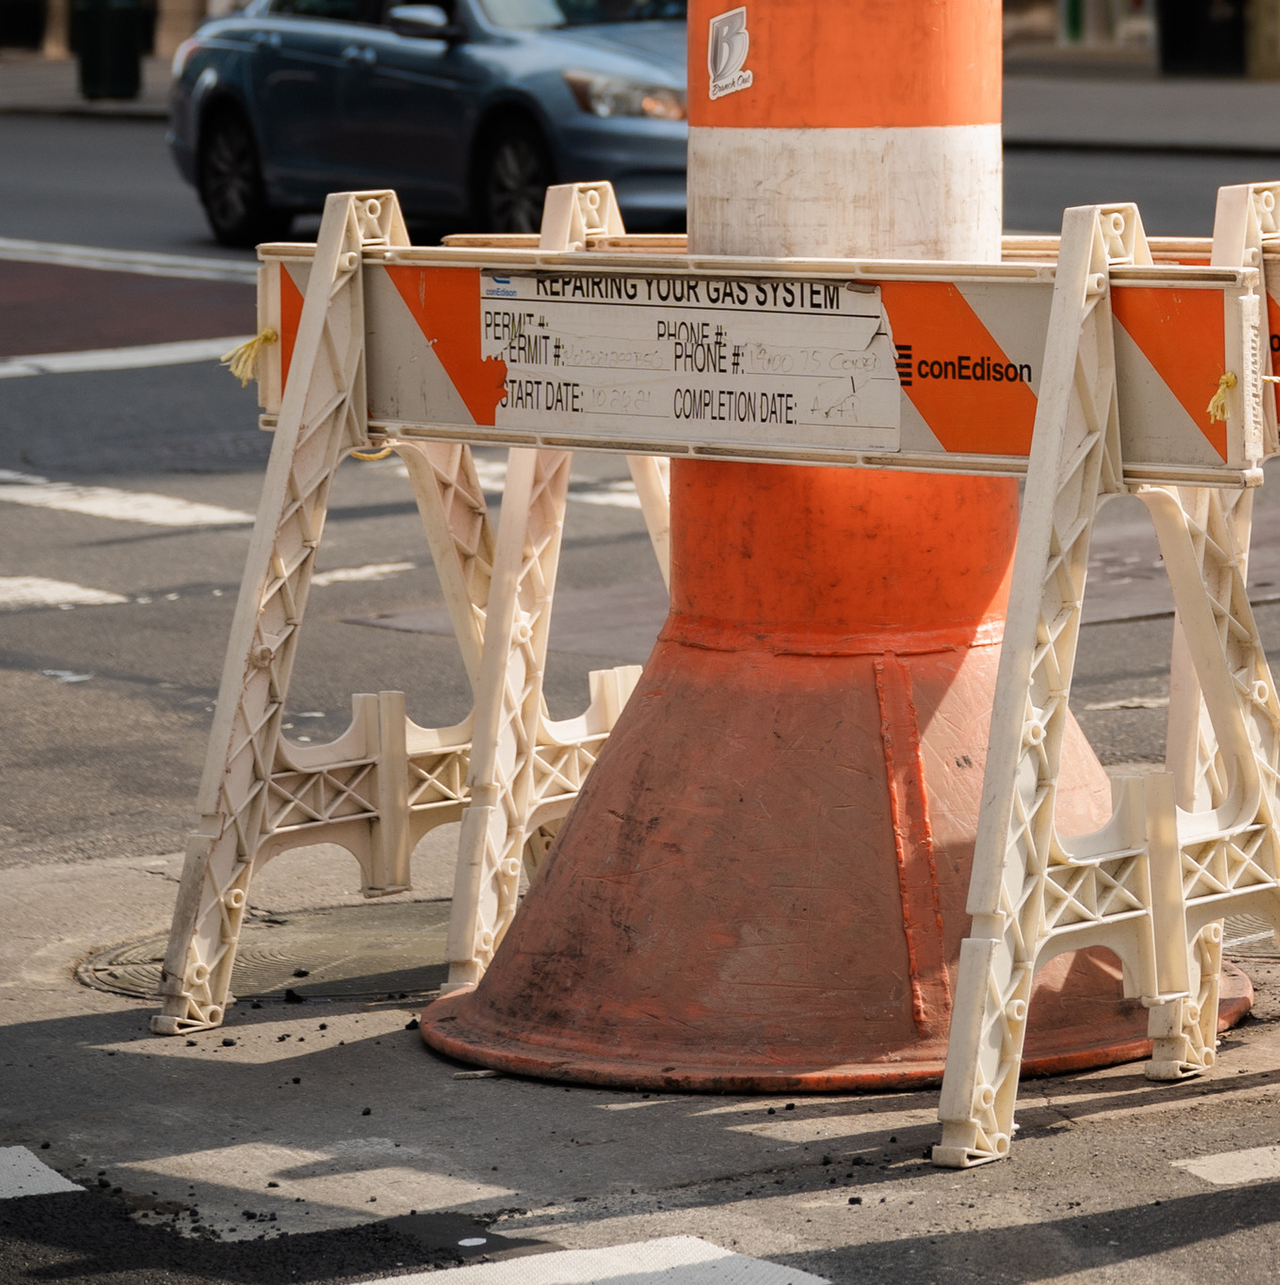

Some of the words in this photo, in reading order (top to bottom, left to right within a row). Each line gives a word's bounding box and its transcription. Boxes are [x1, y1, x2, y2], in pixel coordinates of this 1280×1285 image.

[486, 287, 517, 297] conEdison
[645, 279, 700, 302] YOUR
[501, 334, 550, 365] ERMIT
[674, 342, 727, 373] PHONE
[917, 355, 1032, 382] conEdison
[546, 381, 584, 412] DATE:
[674, 388, 755, 422] COMPLETION
[761, 392, 797, 425] DATE:
